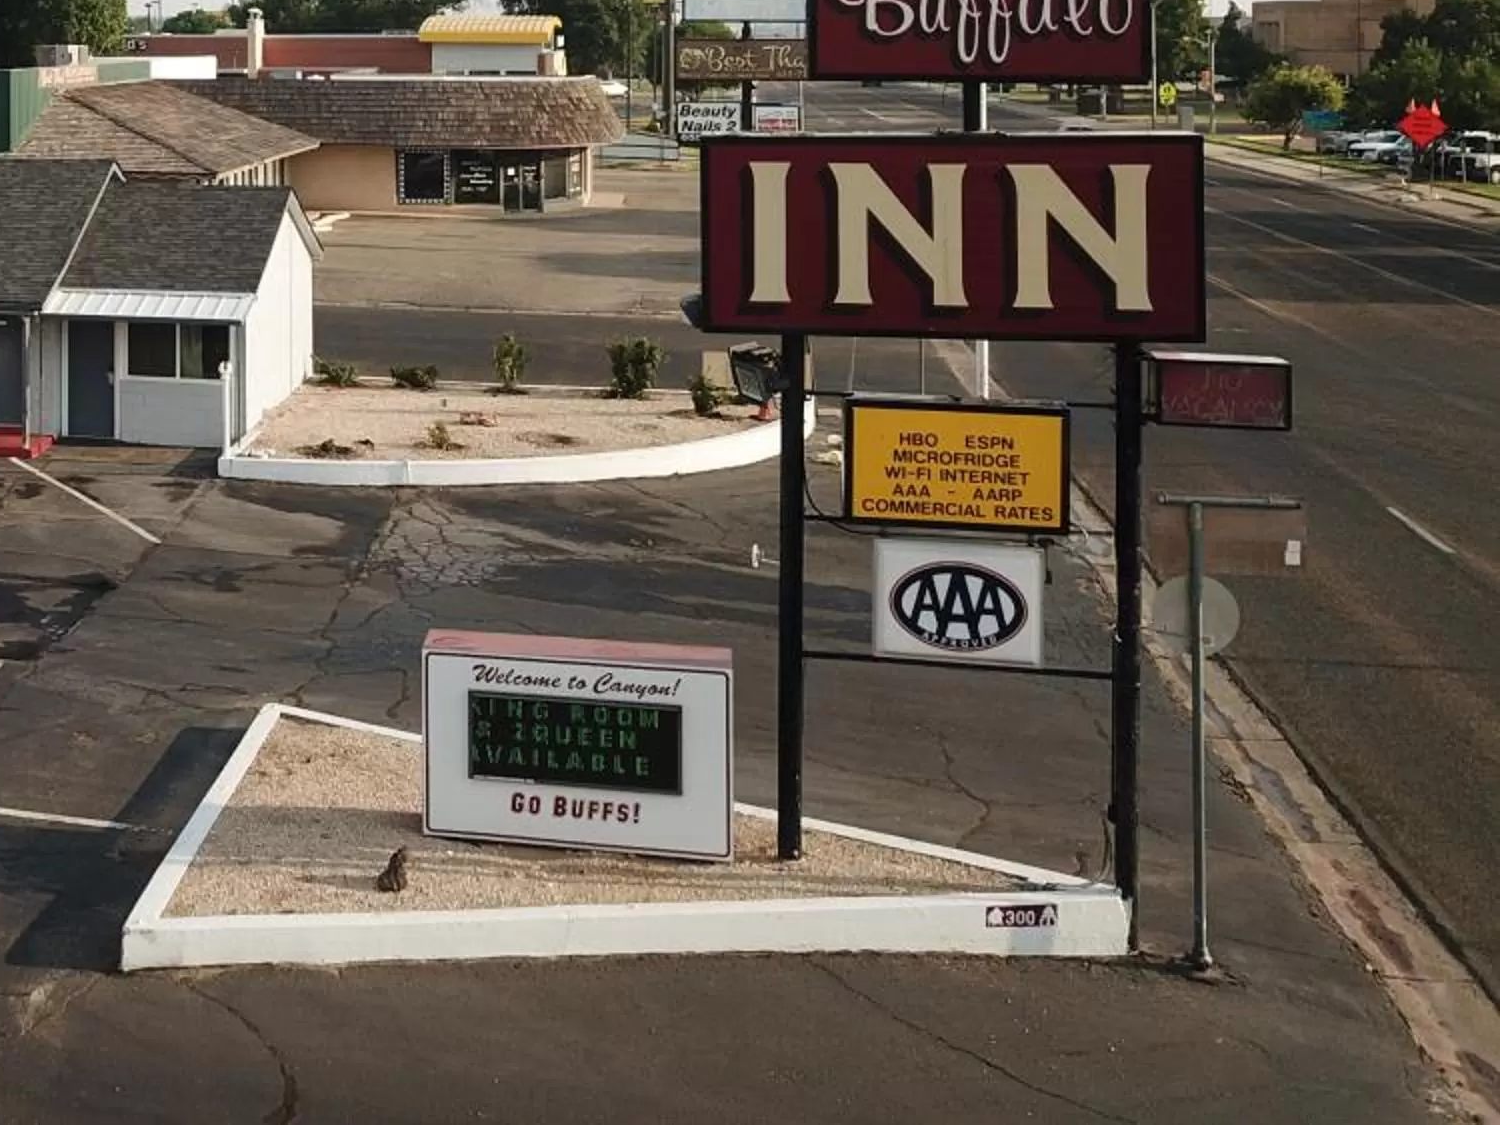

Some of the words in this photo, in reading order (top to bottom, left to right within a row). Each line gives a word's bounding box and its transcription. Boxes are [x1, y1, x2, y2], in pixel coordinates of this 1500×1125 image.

[704, 44, 757, 72] Best
[762, 44, 806, 72] Tha
[680, 104, 737, 119] Beauty
[681, 120, 722, 132] Nails
[726, 121, 737, 132] 2
[748, 161, 1153, 311] INN
[899, 432, 939, 447] HBO
[965, 435, 1014, 450] ESPN
[893, 450, 1021, 468] MICROFRIDGE
[885, 466, 932, 481] WI-FI
[939, 469, 1030, 486] INTERNET
[892, 484, 931, 498] AAA
[973, 488, 1023, 502] AARP
[861, 498, 986, 518] COMMERCIAL
[994, 505, 1054, 521] RATES
[908, 567, 1010, 643] AAA
[472, 664, 561, 689] Welcome
[567, 675, 587, 690] to
[593, 672, 682, 699] Canyon!
[570, 704, 660, 730] ROOM
[511, 792, 541, 814] GO
[553, 796, 640, 824] BUFFS!
[1005, 910, 1036, 925] 300
